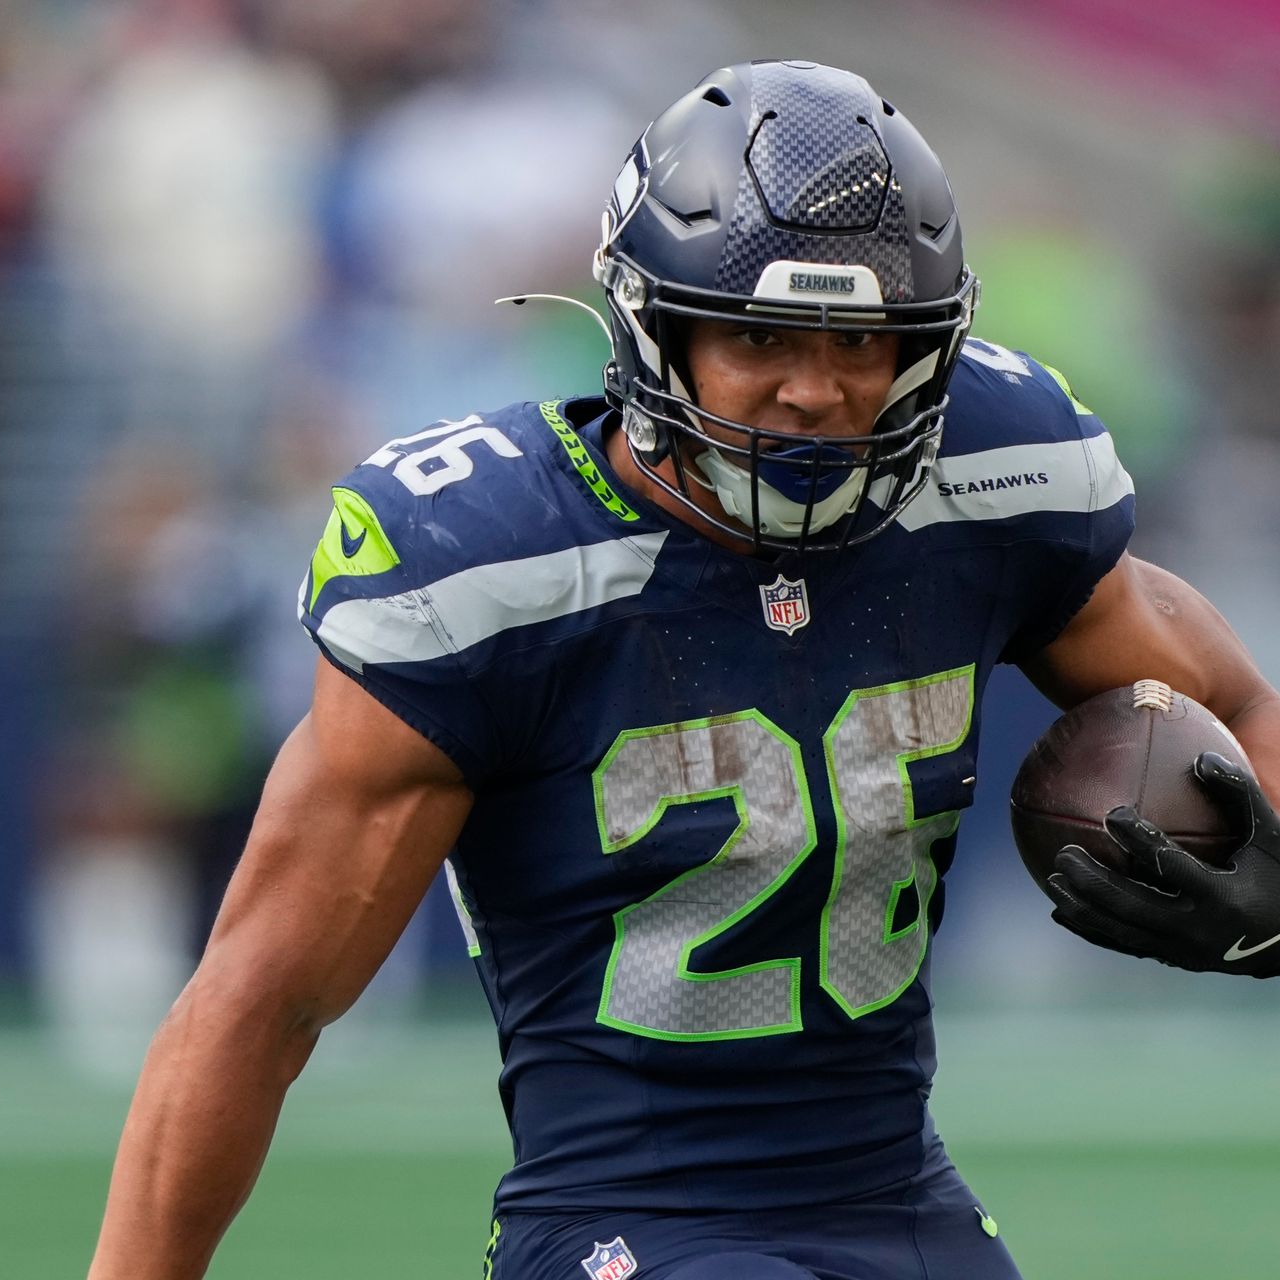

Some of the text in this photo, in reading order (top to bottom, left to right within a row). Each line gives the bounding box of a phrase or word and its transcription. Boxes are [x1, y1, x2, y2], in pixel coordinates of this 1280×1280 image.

[789, 272, 855, 293] SEAHAWKS
[361, 414, 523, 496] 26
[937, 472, 1050, 497] SEAHAWKS
[770, 601, 804, 625] NFL
[592, 662, 977, 1042] 26
